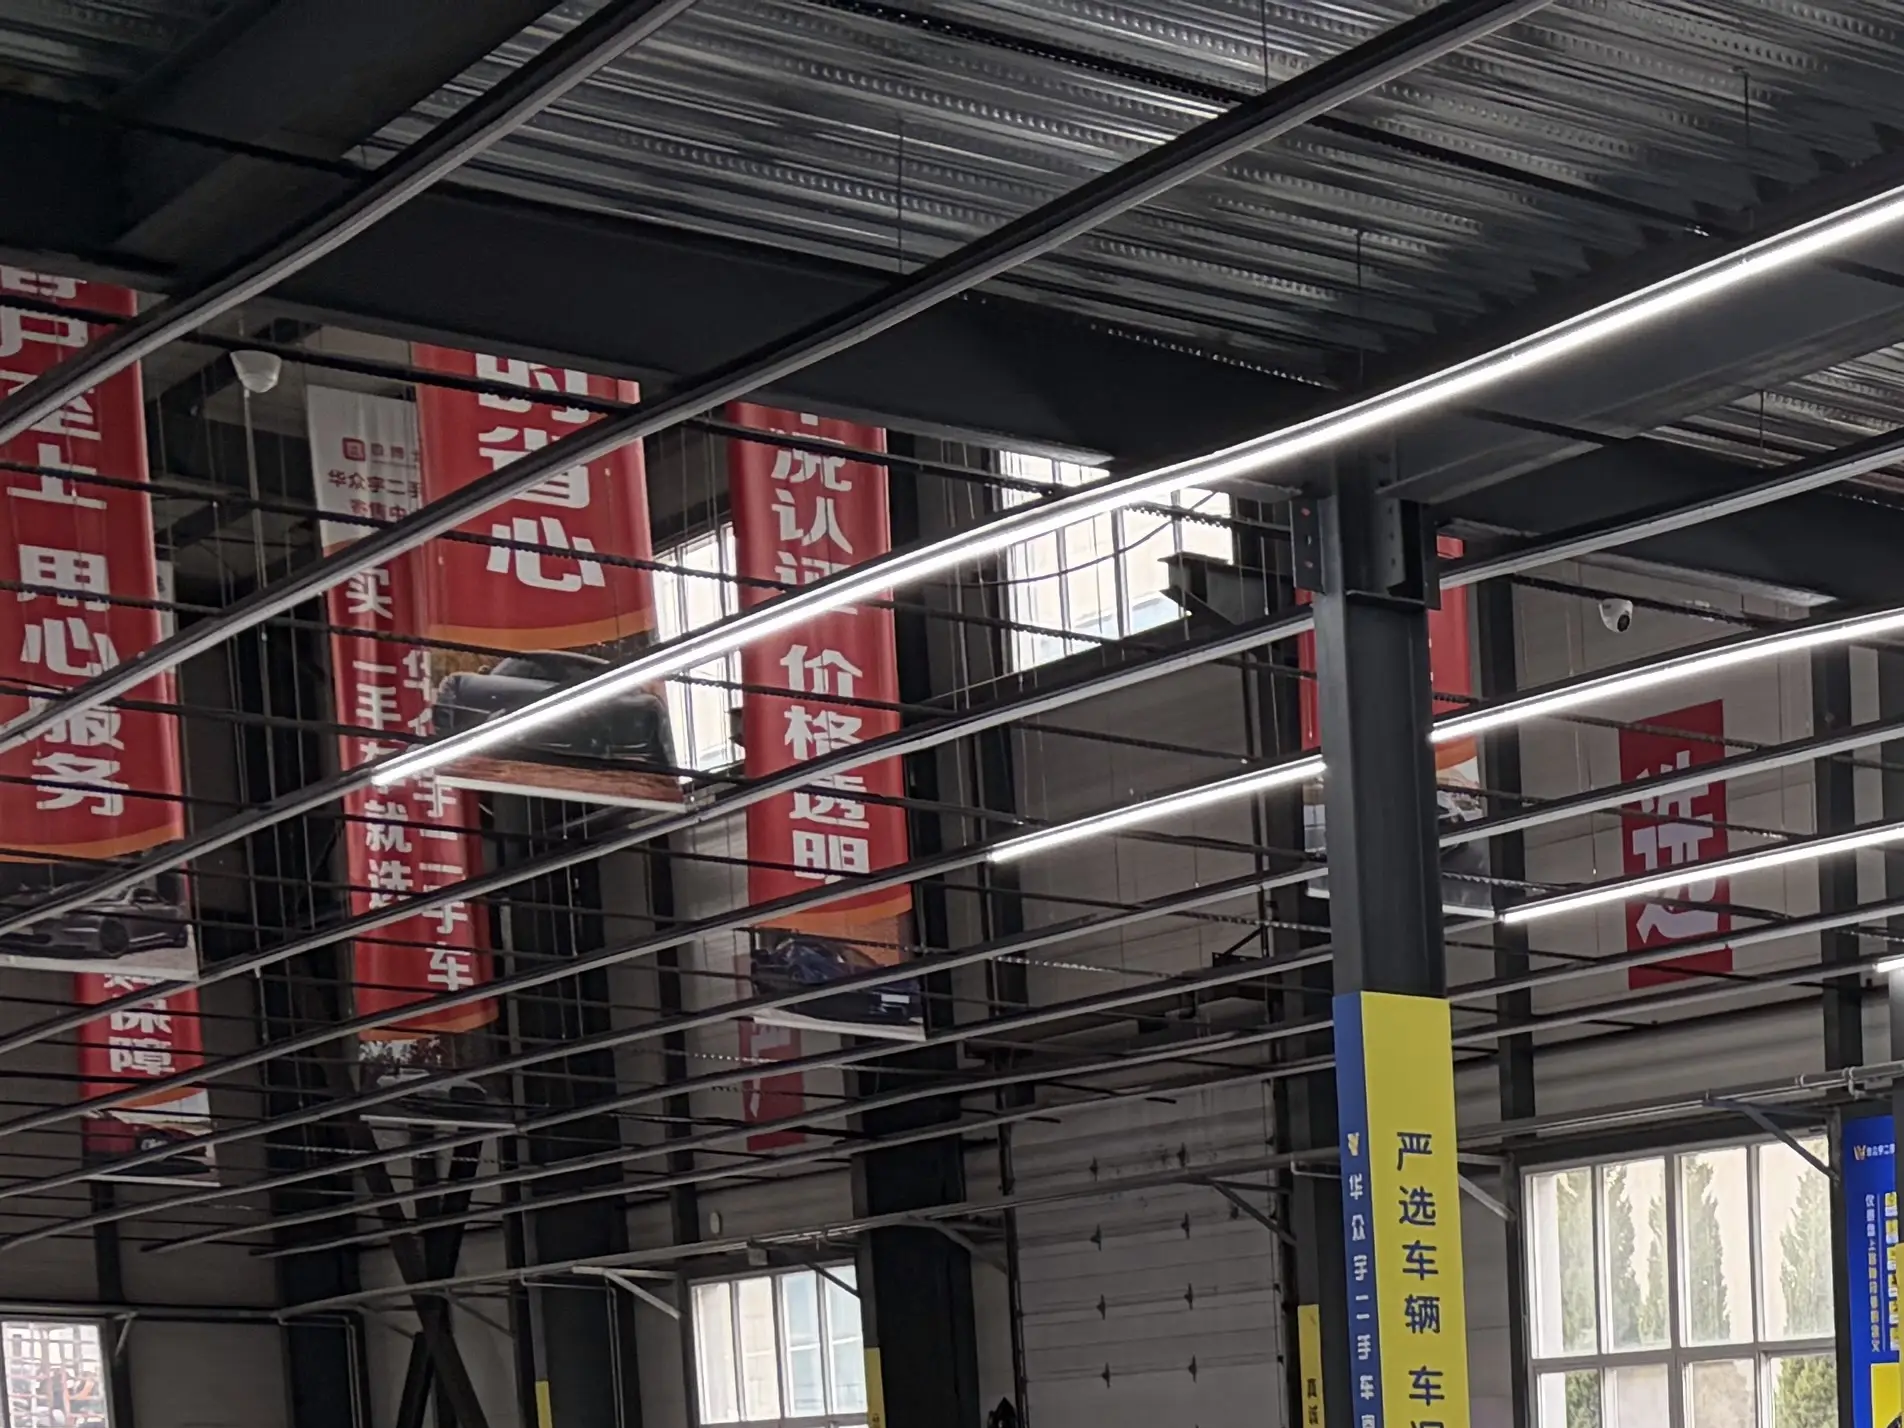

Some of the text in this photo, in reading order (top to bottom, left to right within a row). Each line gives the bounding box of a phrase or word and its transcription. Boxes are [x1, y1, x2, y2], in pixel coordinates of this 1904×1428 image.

[780, 645, 870, 884] 价格透明
[104, 972, 175, 1077] 保障
[1397, 1131, 1441, 1334] 严选车辆
